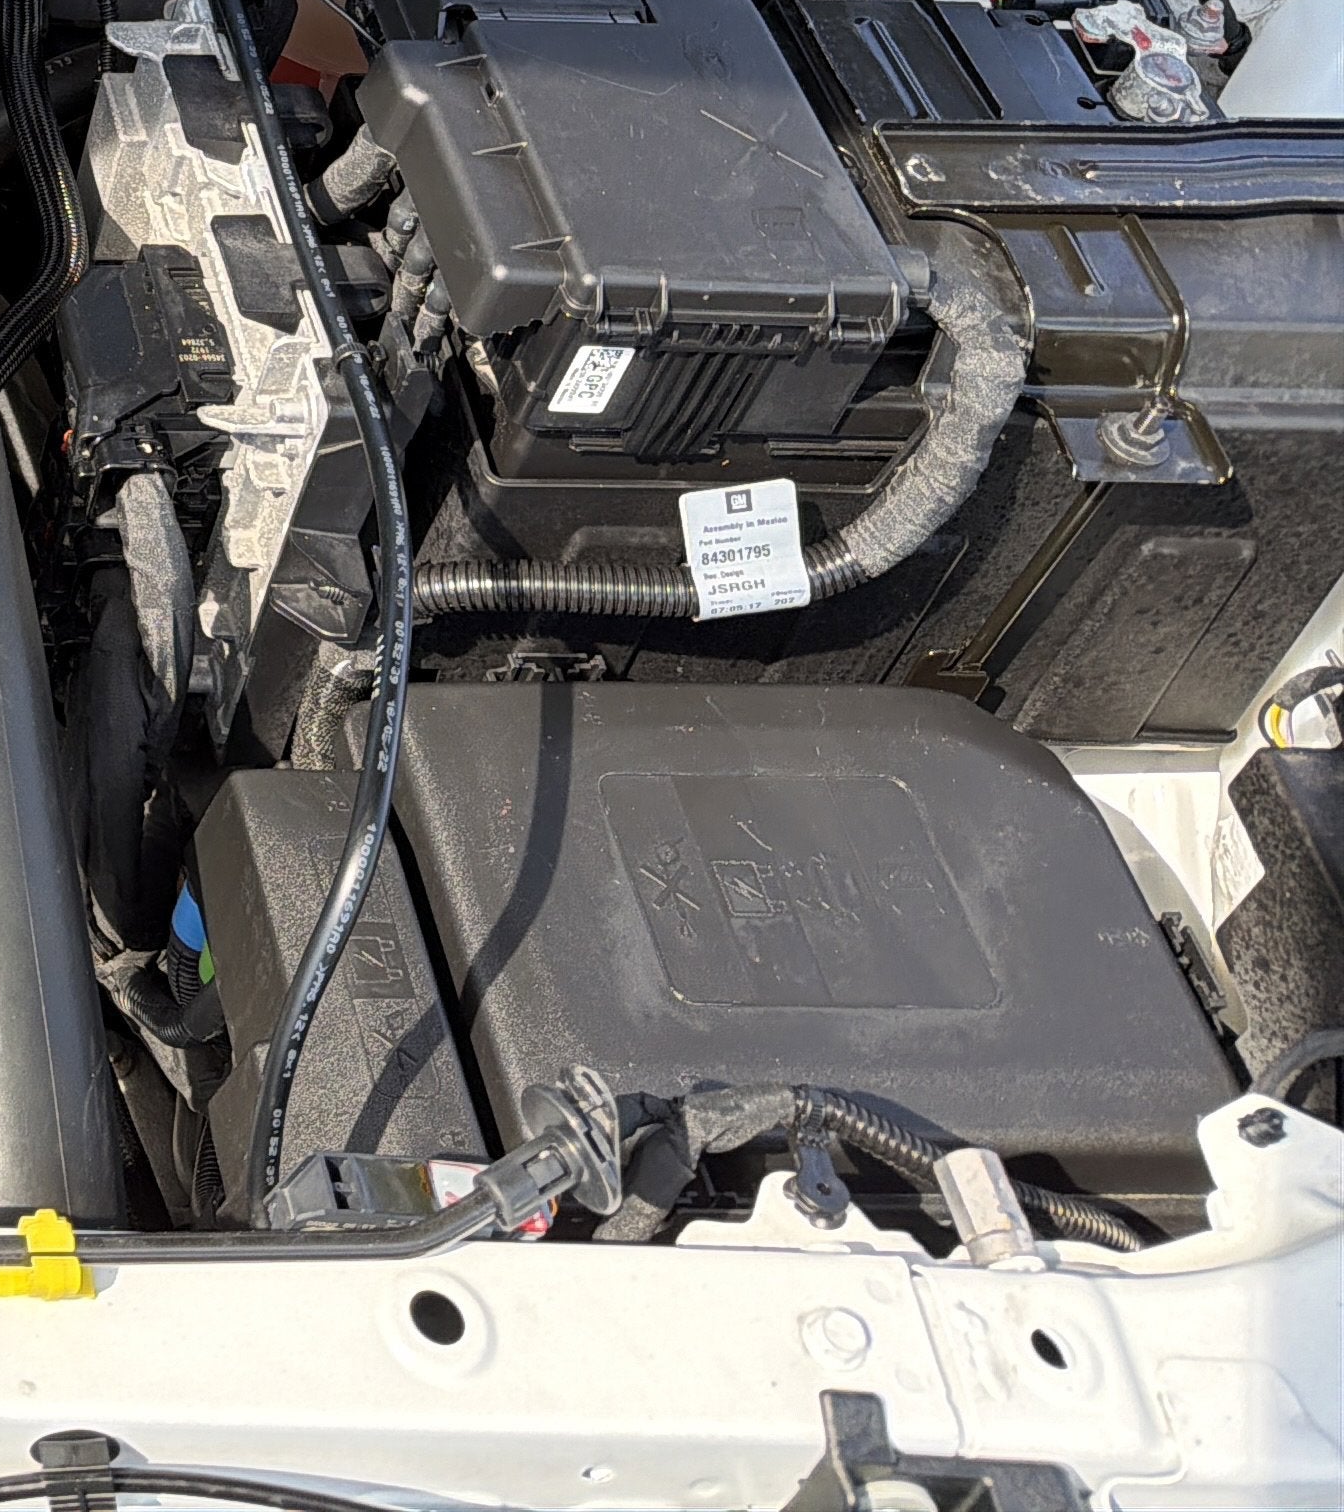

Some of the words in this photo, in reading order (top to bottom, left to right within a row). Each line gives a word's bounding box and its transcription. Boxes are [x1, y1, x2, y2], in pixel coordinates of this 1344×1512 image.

[578, 375, 603, 399] GPC
[729, 492, 748, 510] GM
[703, 522, 744, 533] Assembly
[702, 544, 771, 565] 84301795
[708, 579, 766, 596] JSRGH
